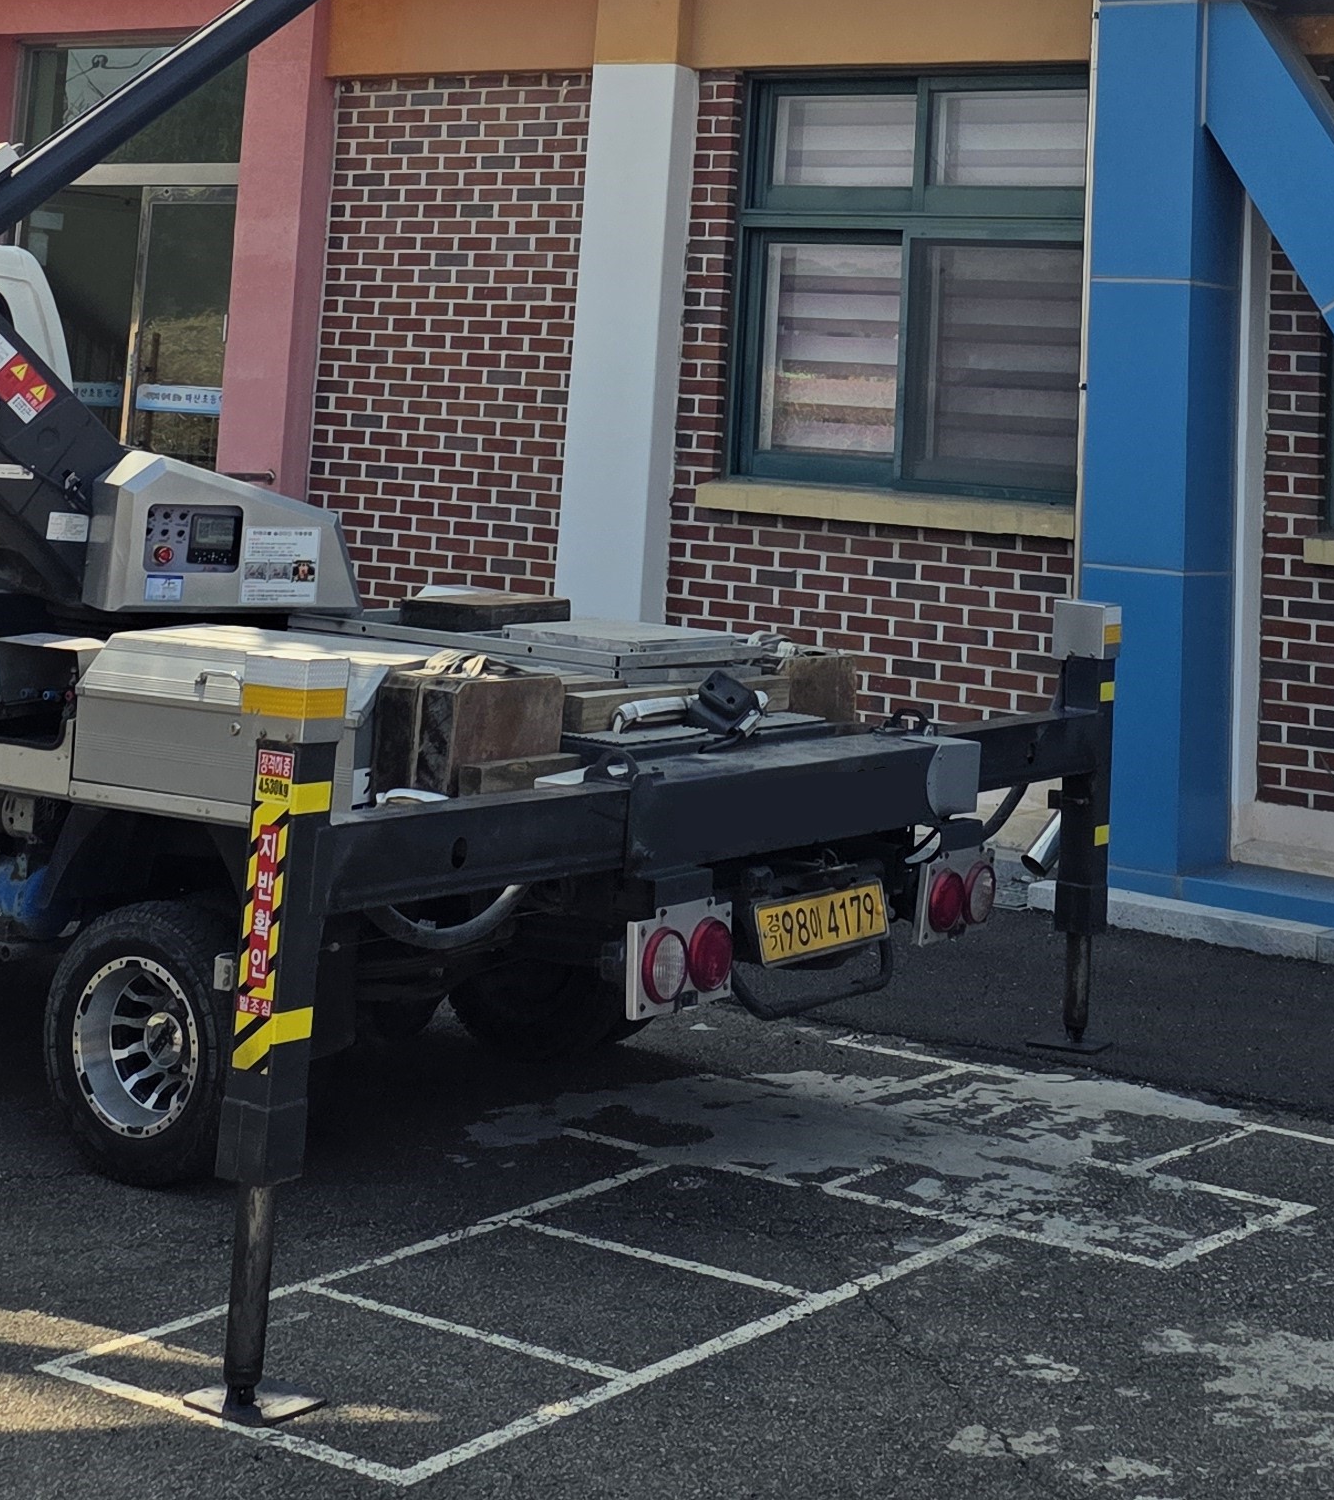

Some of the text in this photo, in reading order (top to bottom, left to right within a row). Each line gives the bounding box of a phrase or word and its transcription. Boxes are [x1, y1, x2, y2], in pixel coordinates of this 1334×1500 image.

[250, 832, 277, 980] 지반확인
[827, 892, 874, 939] 4179
[239, 994, 272, 1018] 발조심
